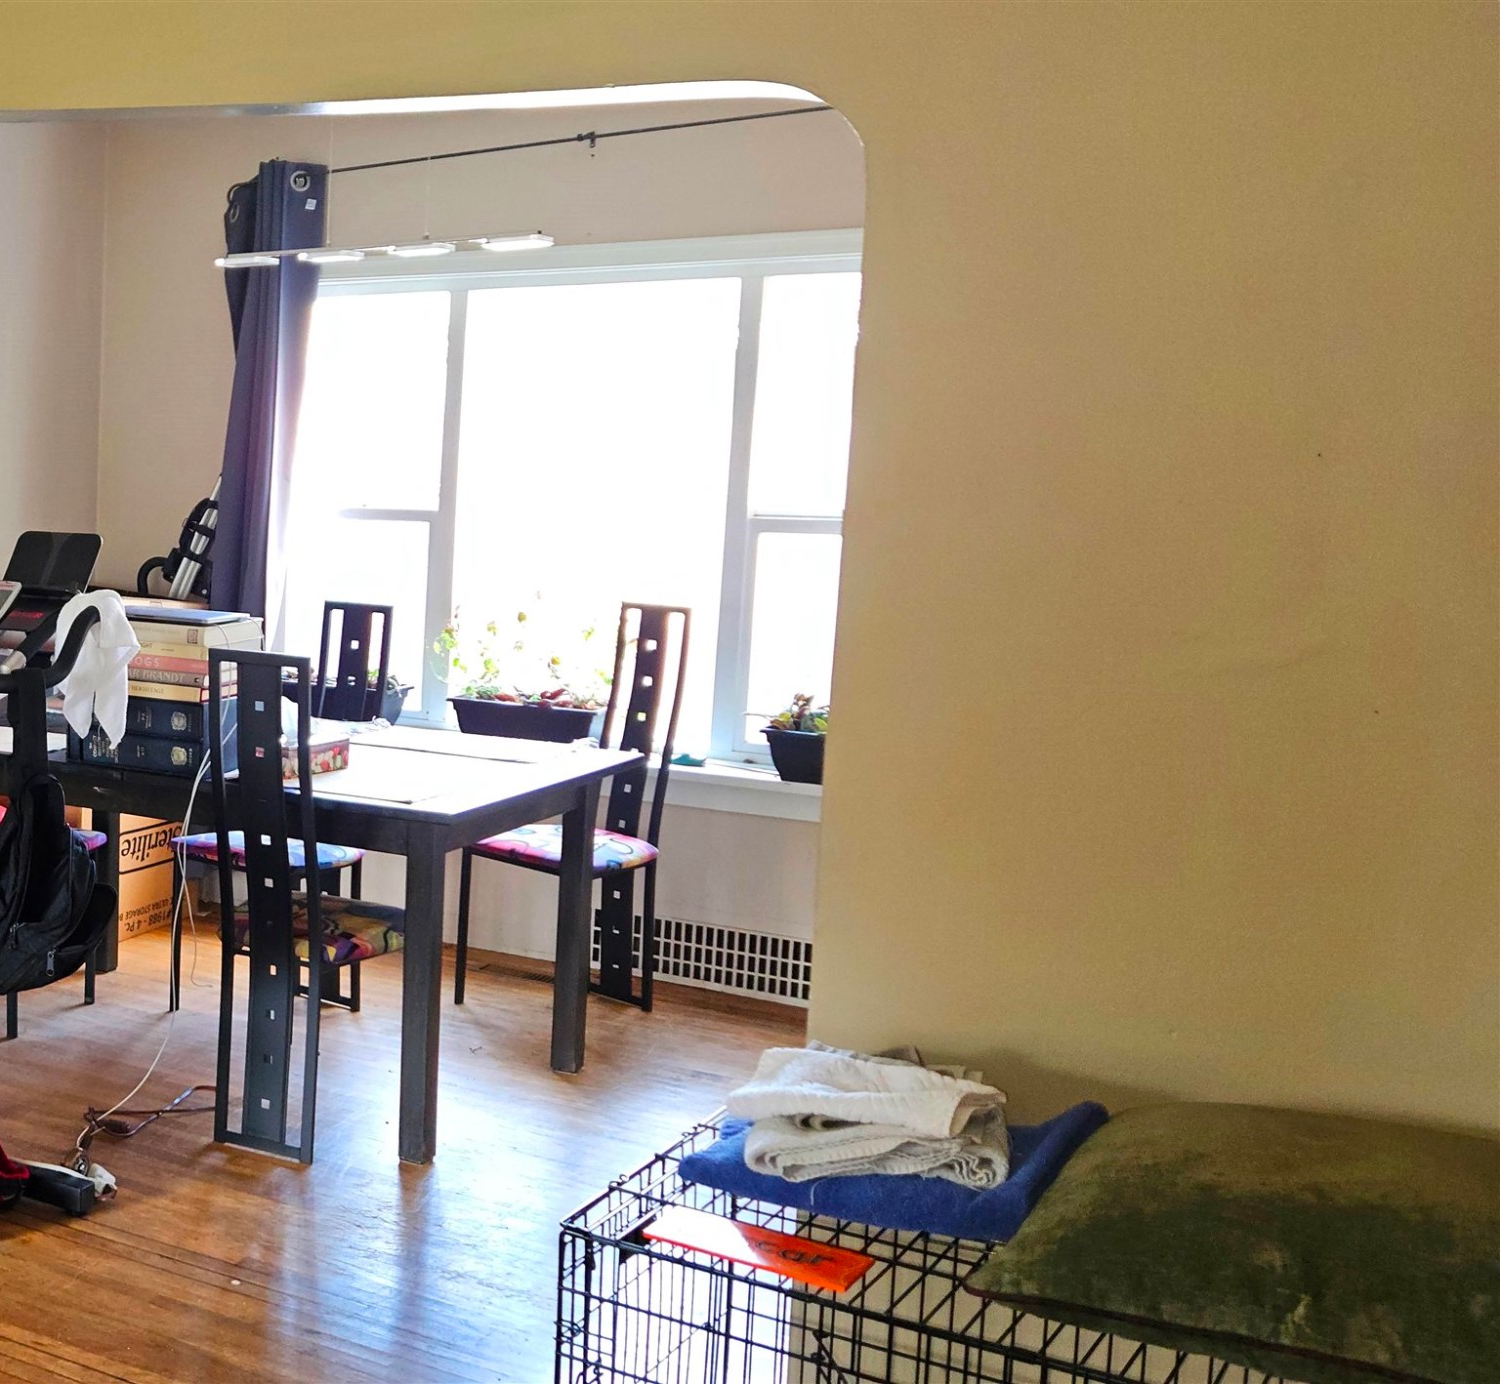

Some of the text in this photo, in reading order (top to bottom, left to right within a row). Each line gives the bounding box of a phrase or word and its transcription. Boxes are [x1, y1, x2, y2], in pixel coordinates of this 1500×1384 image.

[134, 656, 160, 667] OGS
[142, 669, 185, 683] BRANDT
[125, 904, 151, 920] STORAGE
